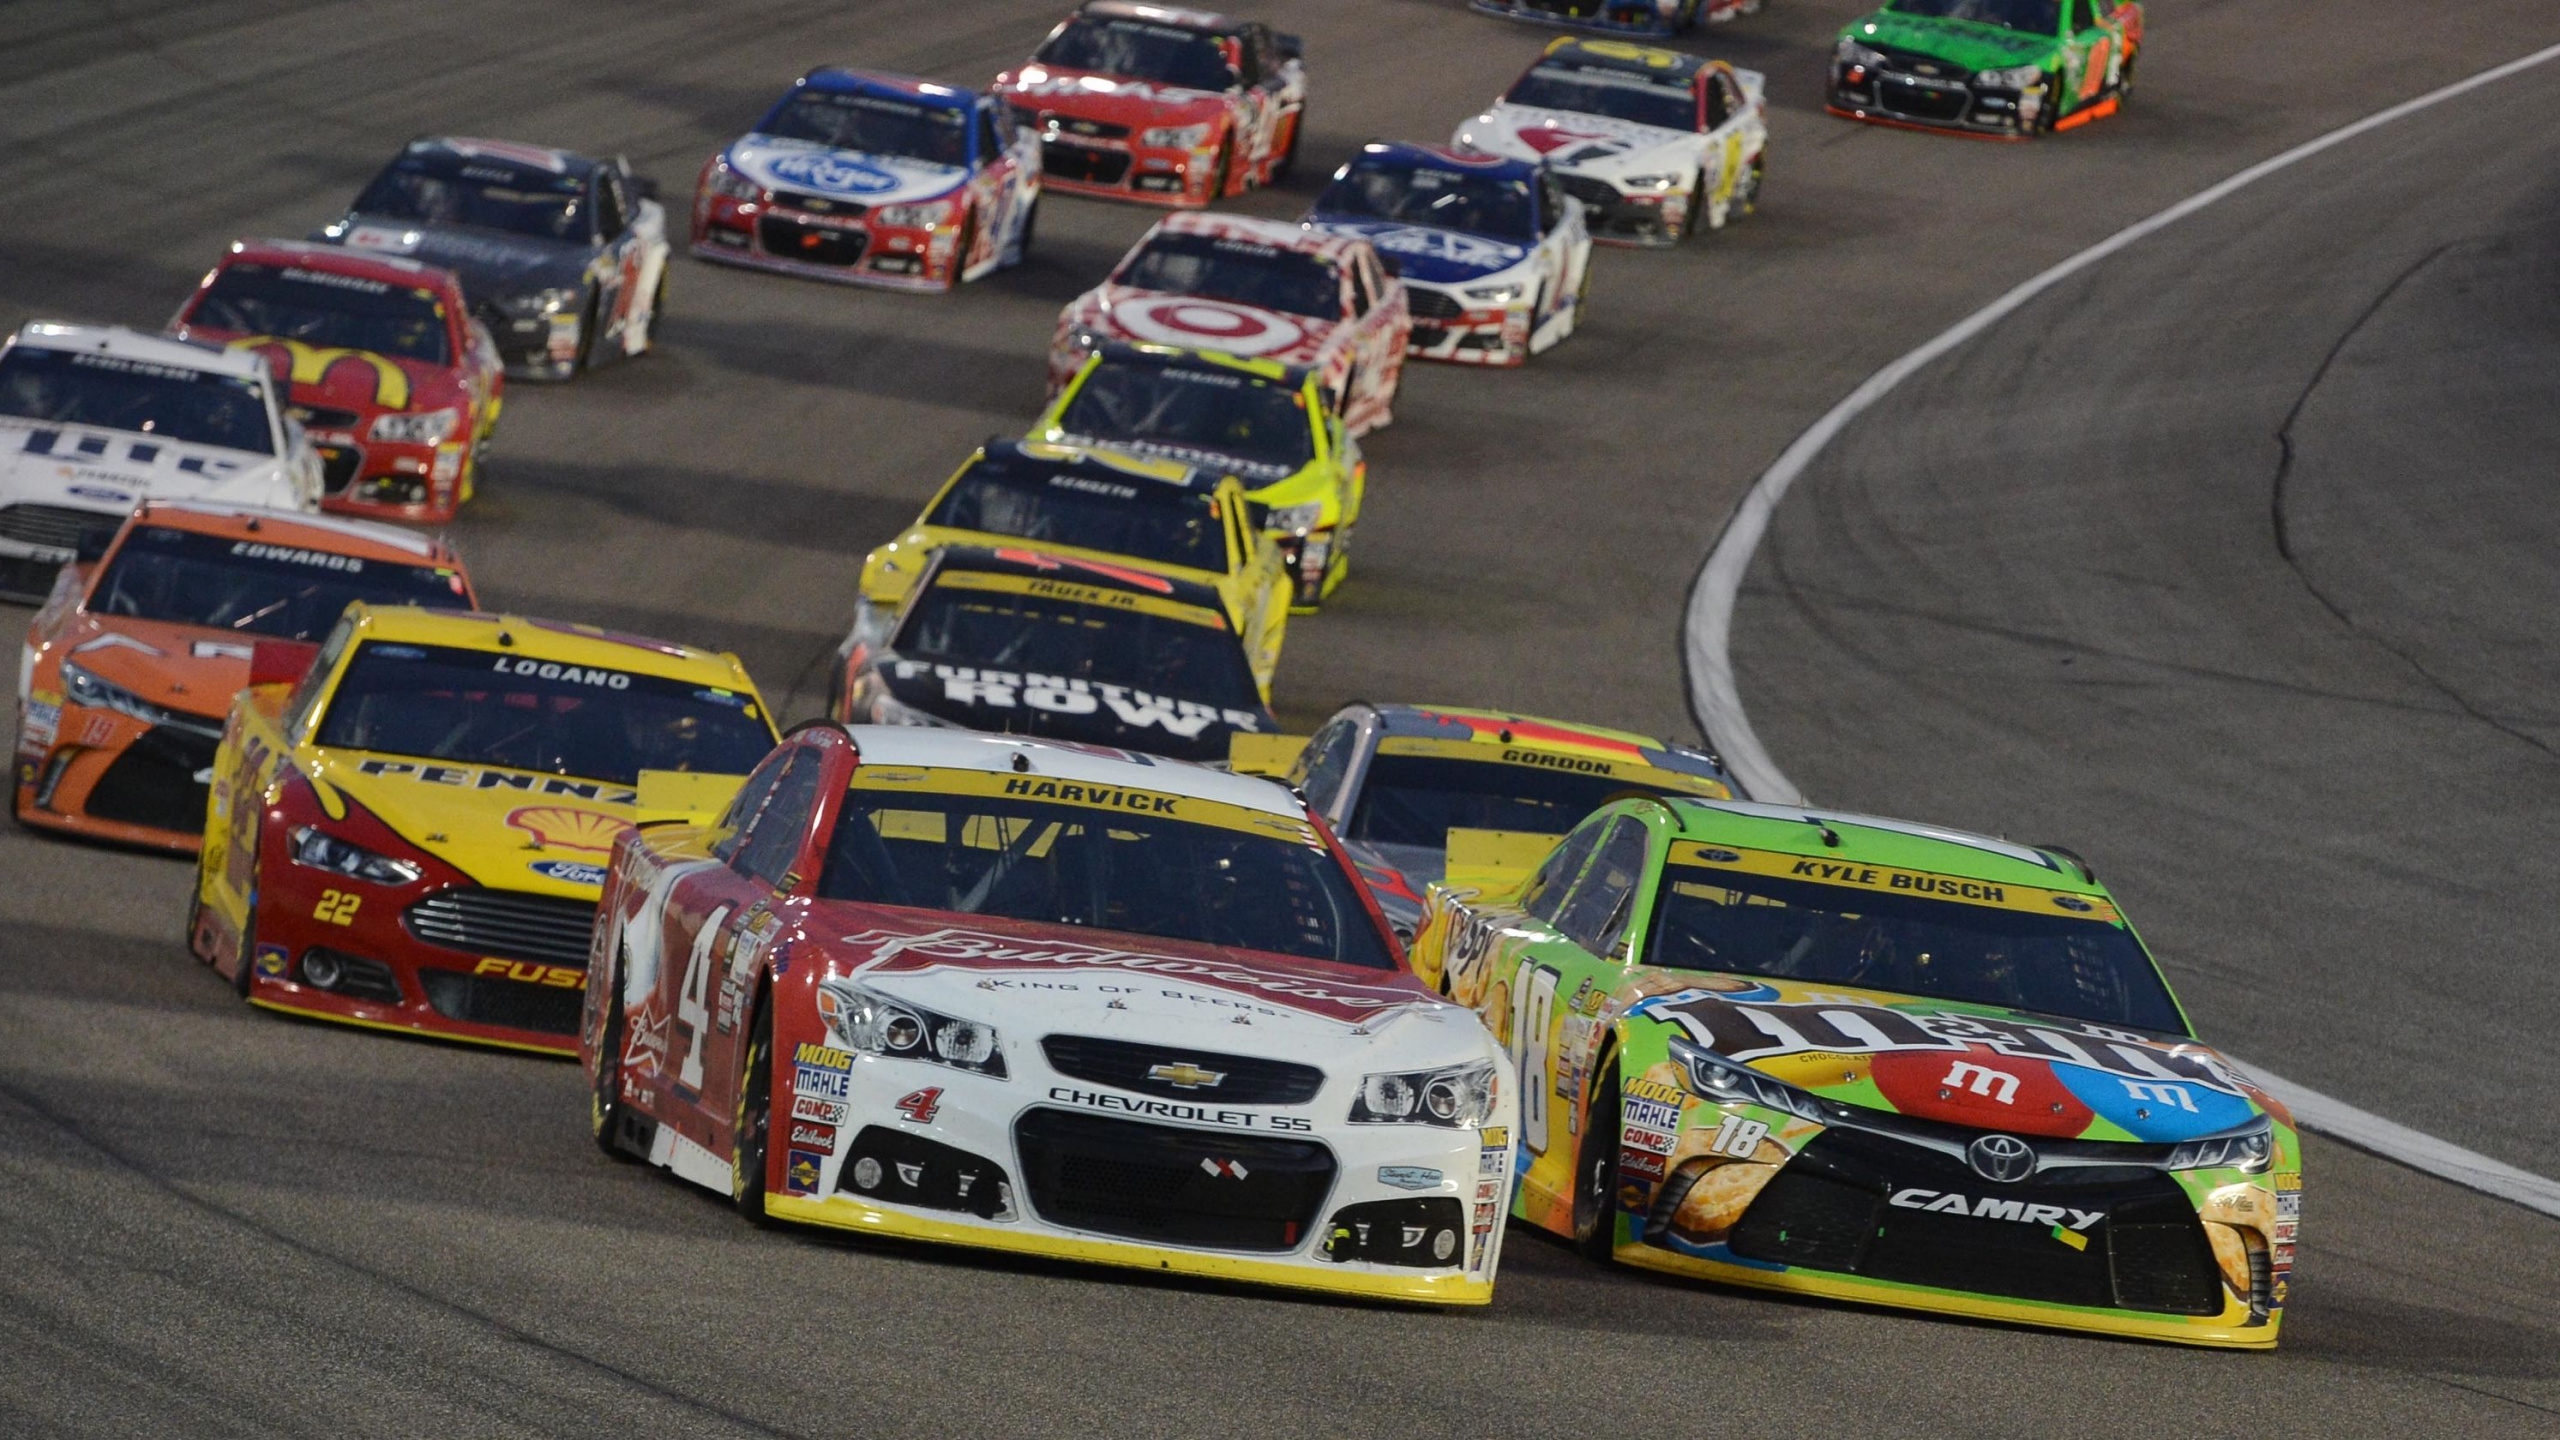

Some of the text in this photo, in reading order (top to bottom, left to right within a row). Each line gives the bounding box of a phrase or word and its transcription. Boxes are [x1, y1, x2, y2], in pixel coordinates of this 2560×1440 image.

[231, 541, 365, 574] EDWARDS
[492, 656, 631, 690] LOGANO
[895, 660, 1260, 732] FURNITURE
[943, 678, 1215, 739] ROW
[1502, 750, 1612, 775] GORDON
[1004, 777, 1179, 815] HARVICK
[1790, 861, 2005, 903] KYLE BUSCH
[313, 888, 362, 927] 22
[872, 930, 1386, 1008] Budweise
[992, 979, 1079, 992] KING
[1098, 985, 1142, 995] OF
[678, 904, 732, 1091] 4
[794, 1043, 856, 1071] MOOG
[795, 1069, 850, 1098] MAHLE
[1625, 1077, 1685, 1105] MOOG
[796, 1099, 832, 1116] COMP
[894, 1086, 944, 1124] 4
[1049, 1087, 1312, 1132] CHEVROLET SS
[1624, 1101, 1680, 1130] MAHLE
[1623, 1128, 1665, 1147] COMP
[1710, 1115, 1770, 1159] 18
[1889, 1188, 2106, 1230] CAMRY
